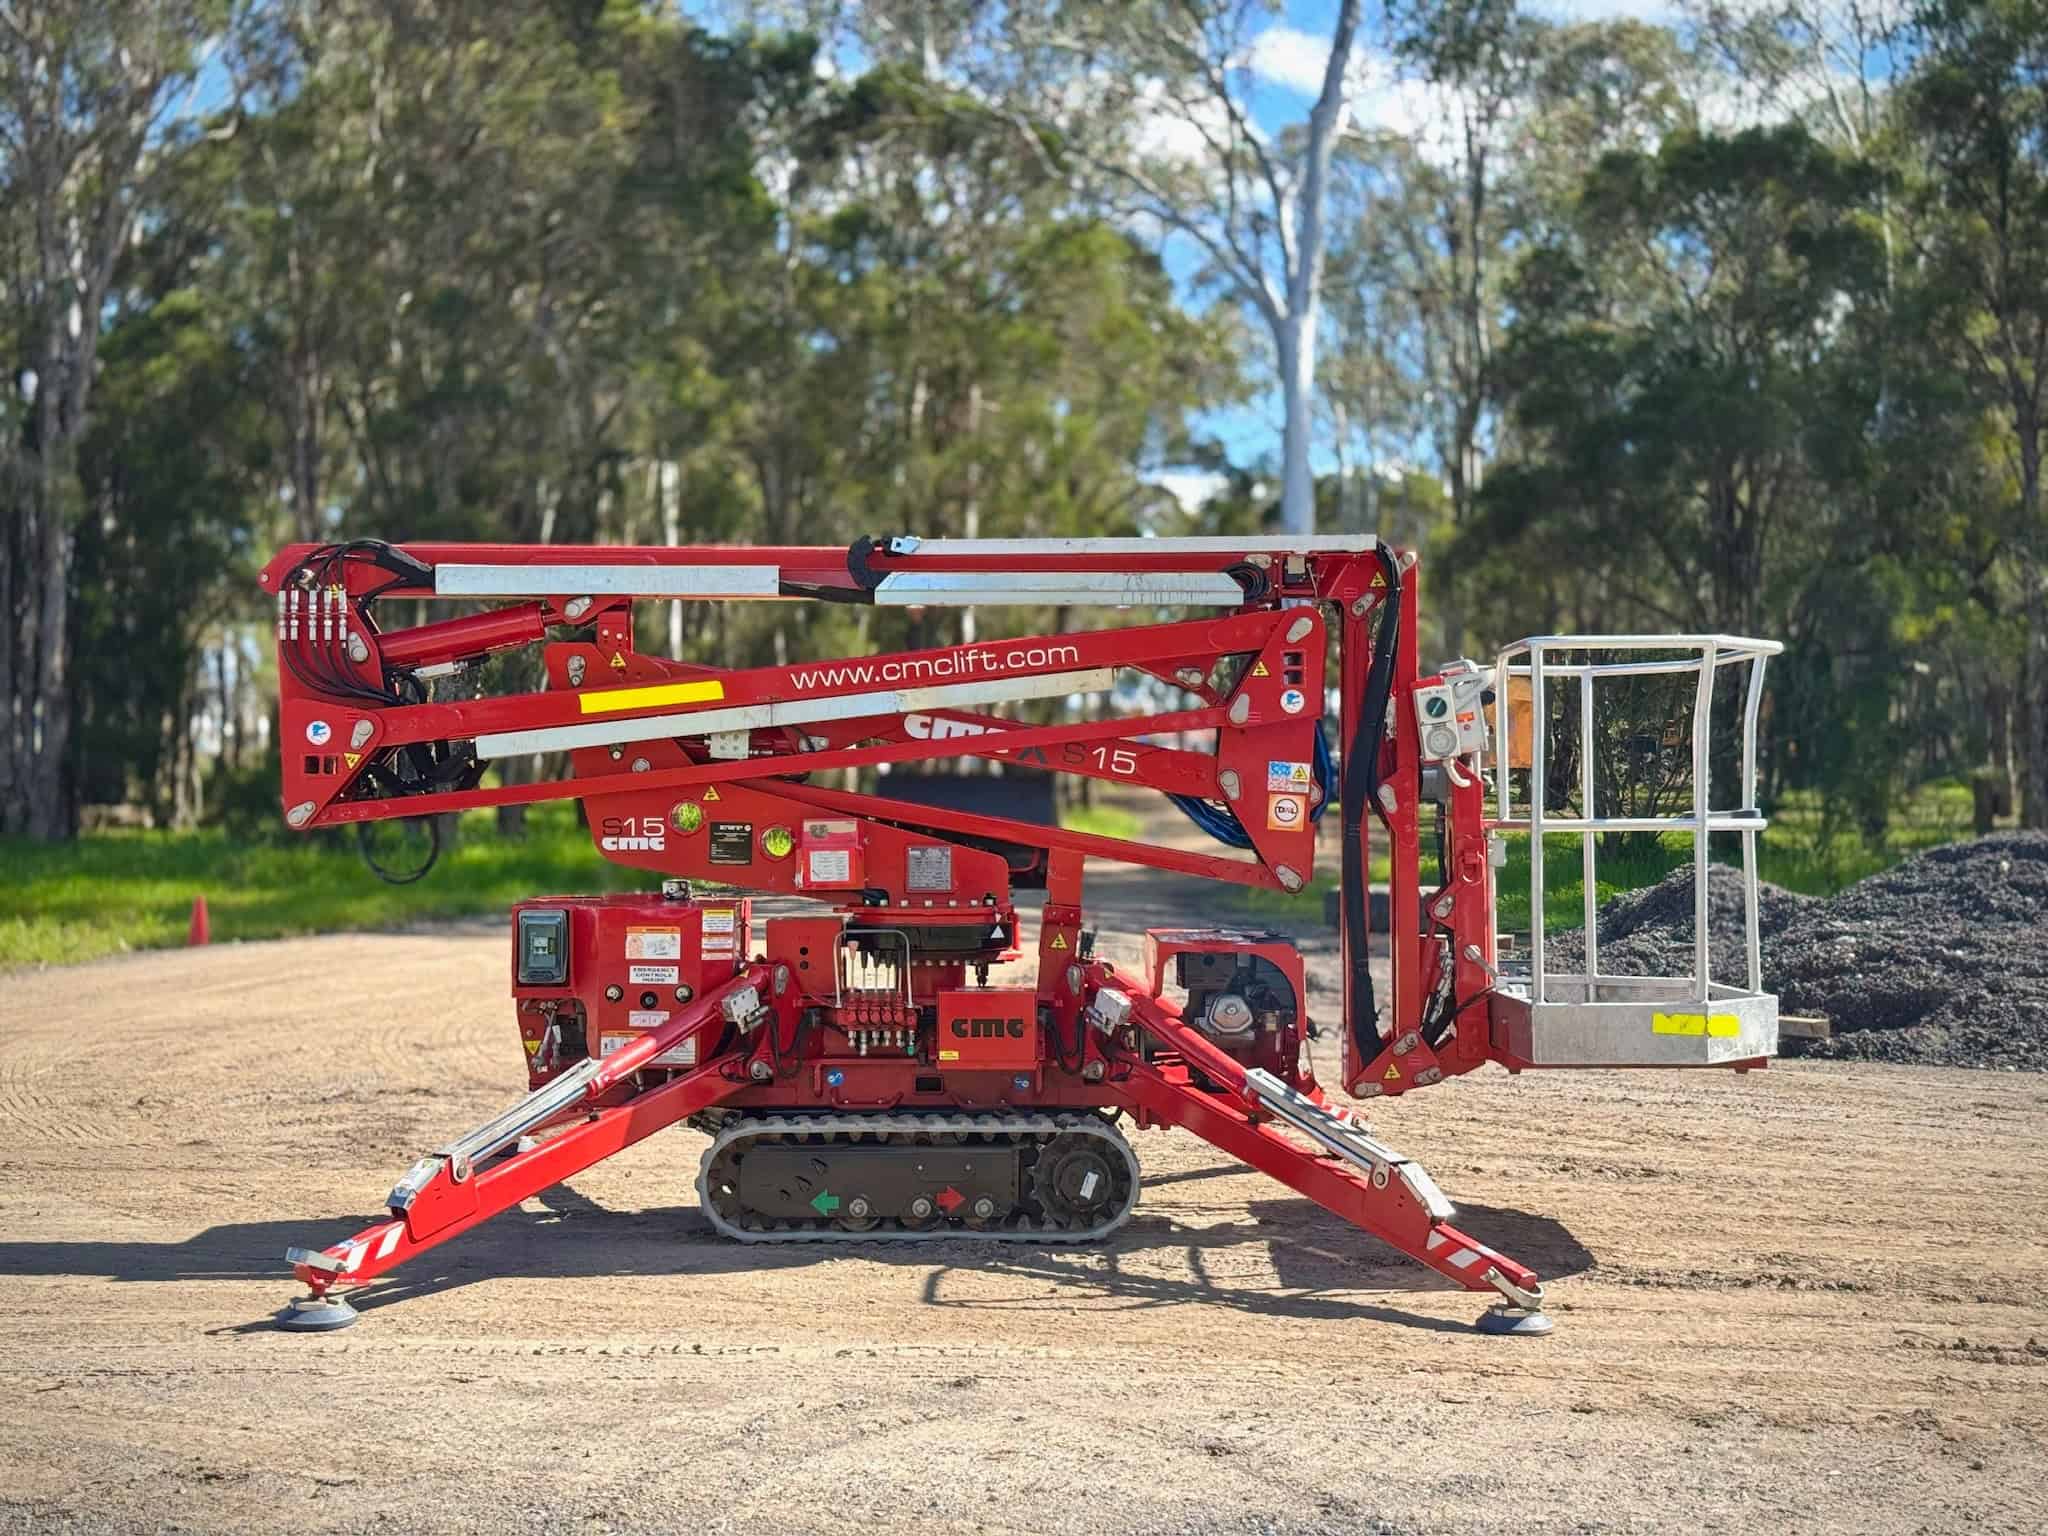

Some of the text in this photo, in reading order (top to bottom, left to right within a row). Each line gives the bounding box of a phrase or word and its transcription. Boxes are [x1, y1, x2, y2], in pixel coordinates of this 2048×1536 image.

[790, 646, 1079, 690] www.cmclift.com
[904, 713, 1009, 753] cm
[1062, 742, 1138, 775] S15
[602, 817, 665, 837] S15
[601, 837, 665, 851] cmc
[951, 1018, 1024, 1037] cmc
